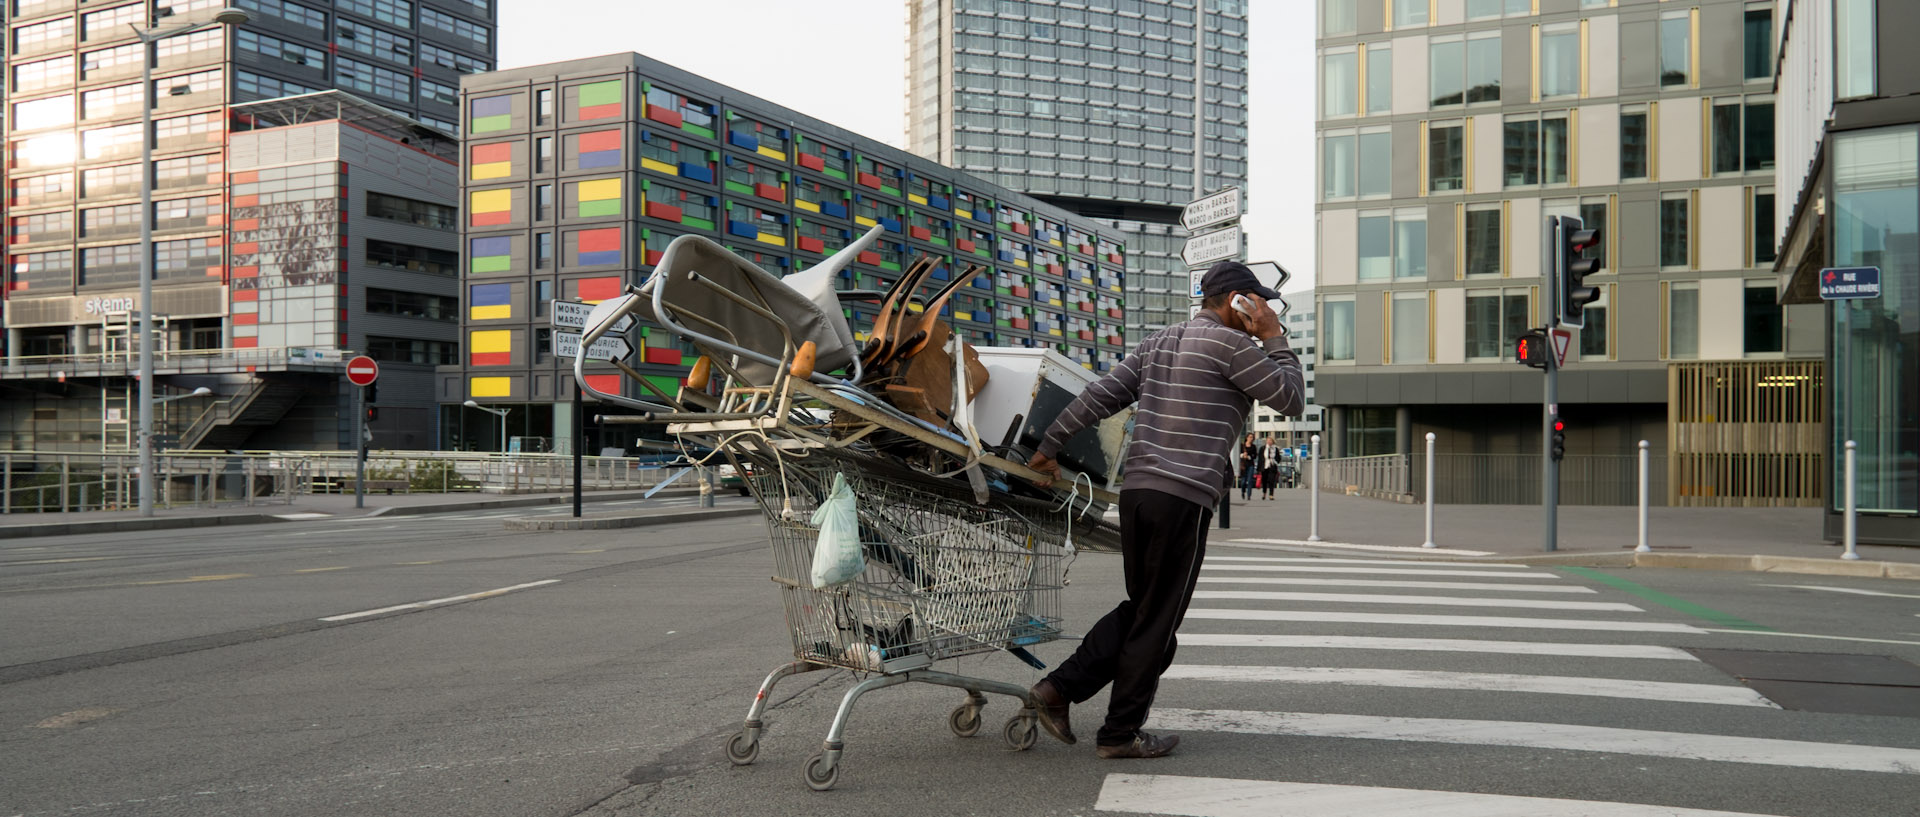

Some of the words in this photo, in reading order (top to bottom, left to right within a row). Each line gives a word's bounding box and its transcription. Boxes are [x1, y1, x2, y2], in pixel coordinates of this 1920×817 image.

[1189, 203, 1203, 214] MONS
[1189, 214, 1206, 225] MARCO
[1191, 238, 1207, 250] SAINT
[1210, 230, 1236, 245] MAURICE
[1843, 272, 1856, 282] RUE
[1822, 286, 1828, 294] de
[1835, 284, 1857, 294] CHAUDE
[85, 296, 134, 315] skema
[558, 305, 580, 314] MONS
[558, 316, 584, 325] MARCO
